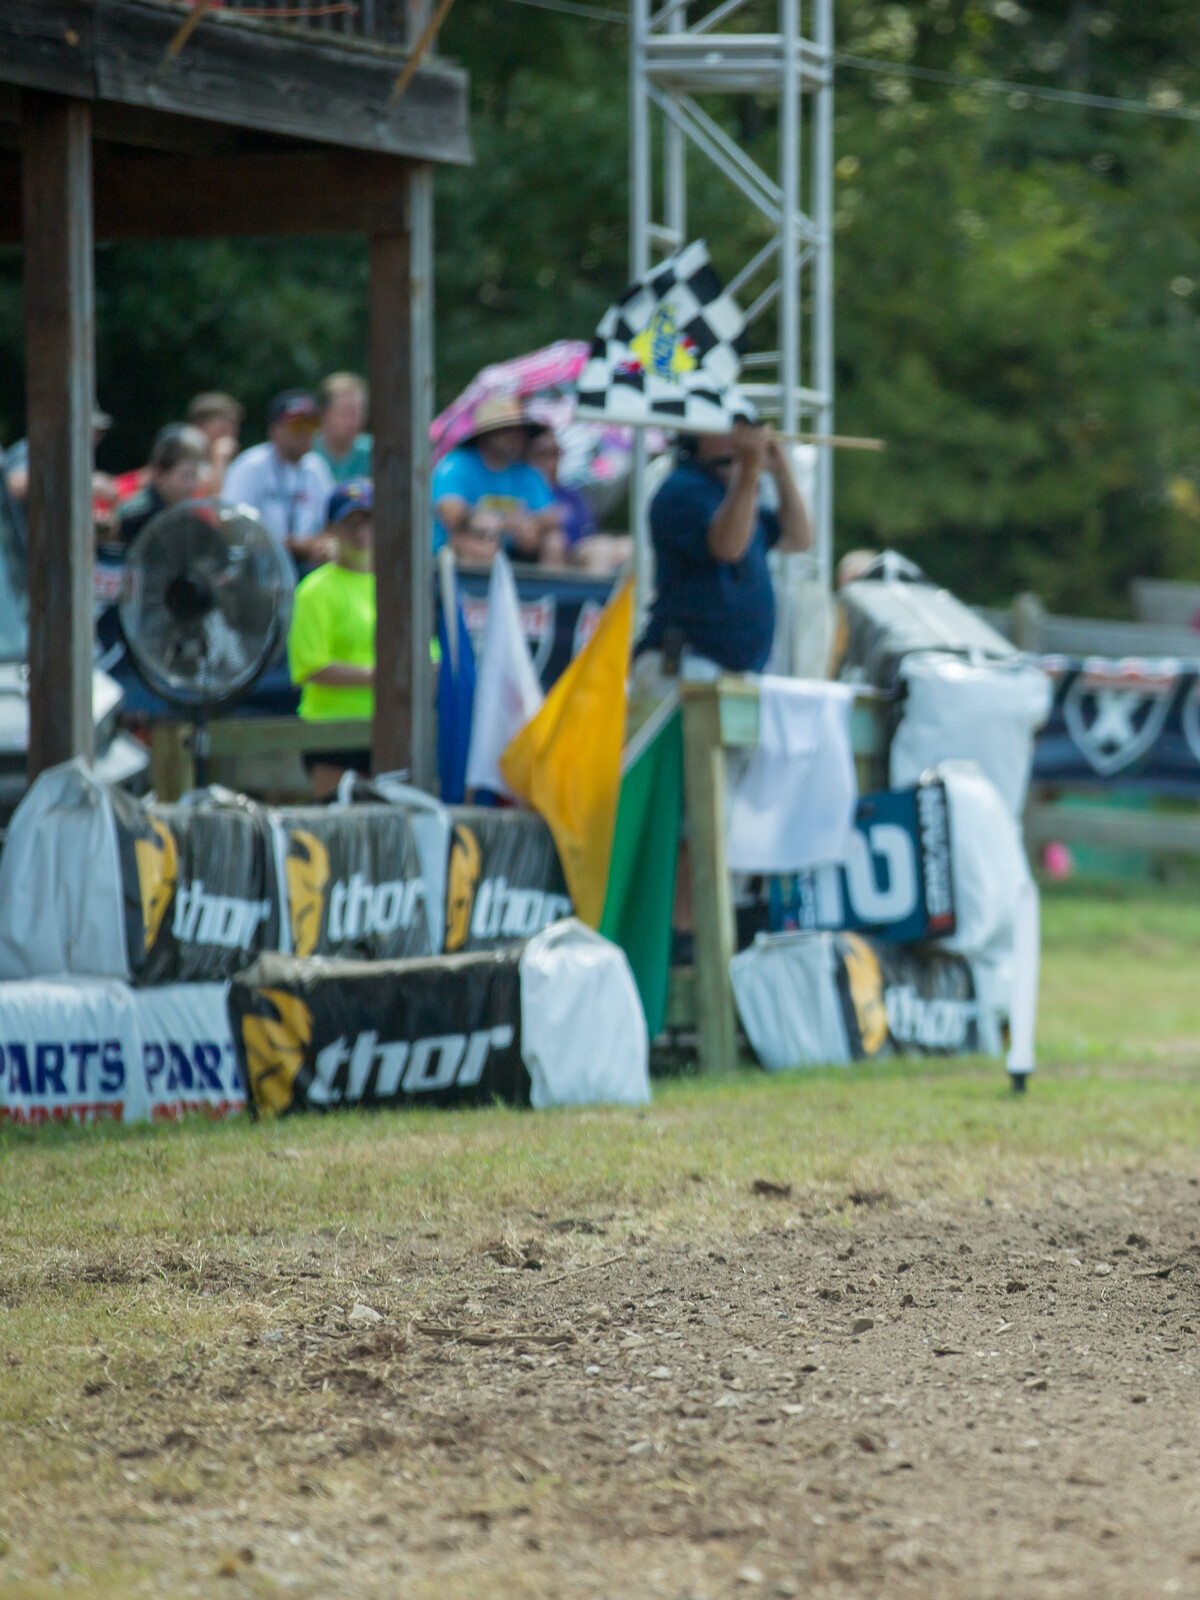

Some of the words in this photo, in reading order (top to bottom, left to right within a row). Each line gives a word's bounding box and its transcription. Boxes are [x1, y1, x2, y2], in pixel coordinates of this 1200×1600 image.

[172, 879, 271, 950] thor
[327, 872, 425, 943] thor
[471, 875, 572, 937] thor
[0, 1039, 126, 1095] ARTS
[308, 1025, 514, 1103] thor
